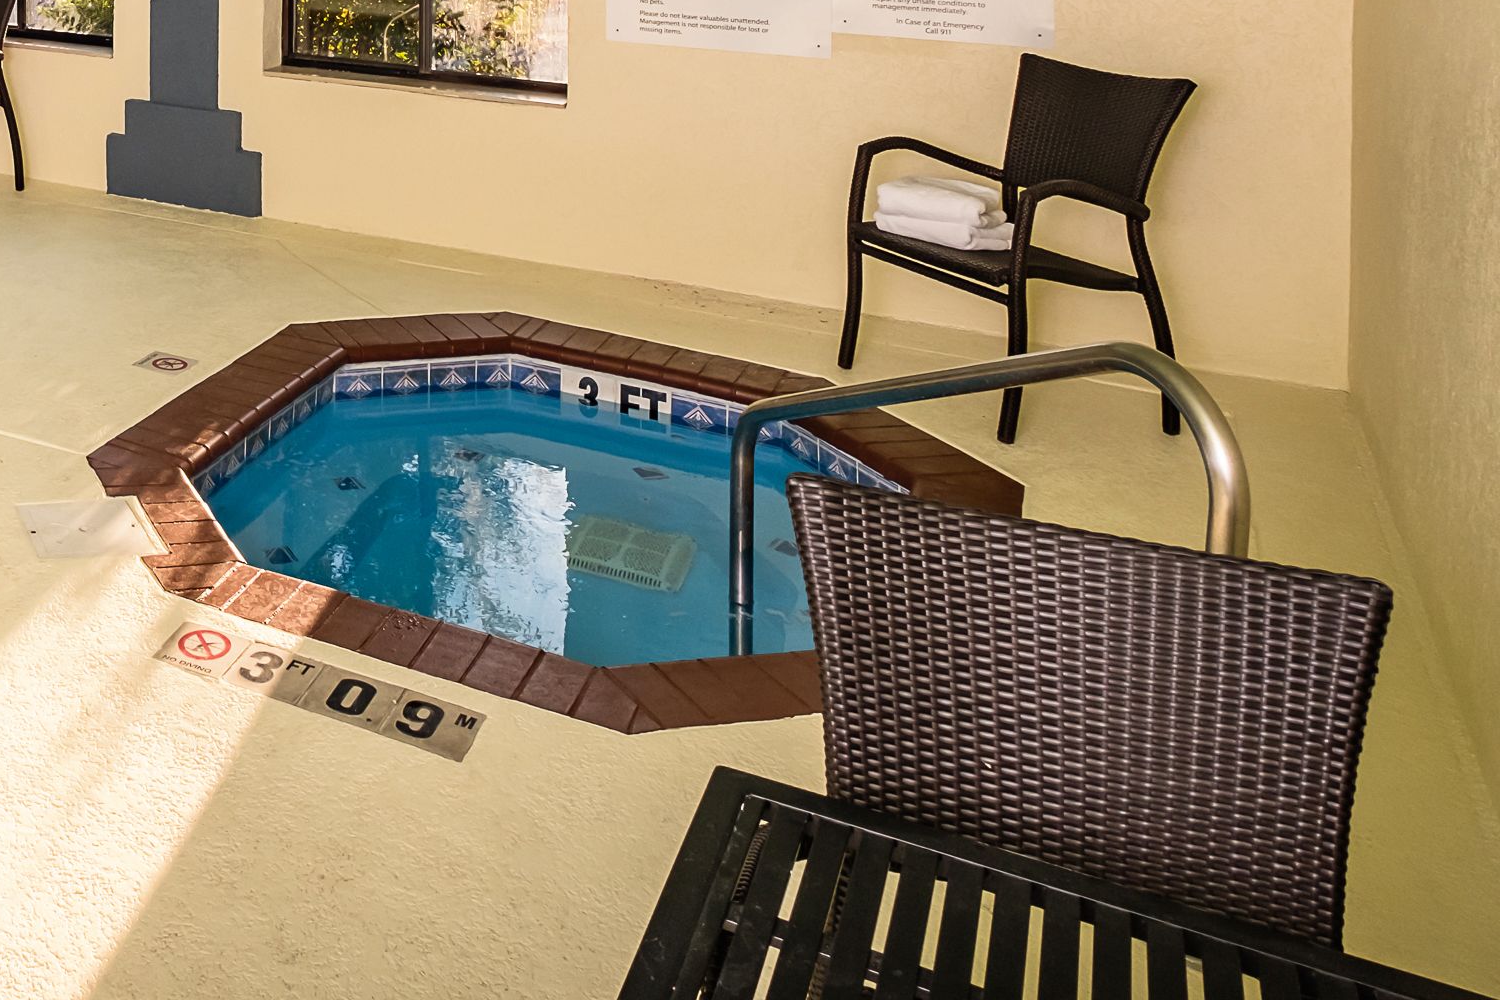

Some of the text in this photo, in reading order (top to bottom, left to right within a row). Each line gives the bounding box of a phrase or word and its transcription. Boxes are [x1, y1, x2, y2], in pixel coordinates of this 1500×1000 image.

[579, 377, 667, 420] 3 FT
[162, 654, 177, 662] NO
[239, 651, 315, 684] 3 FT
[454, 713, 478, 730] M
